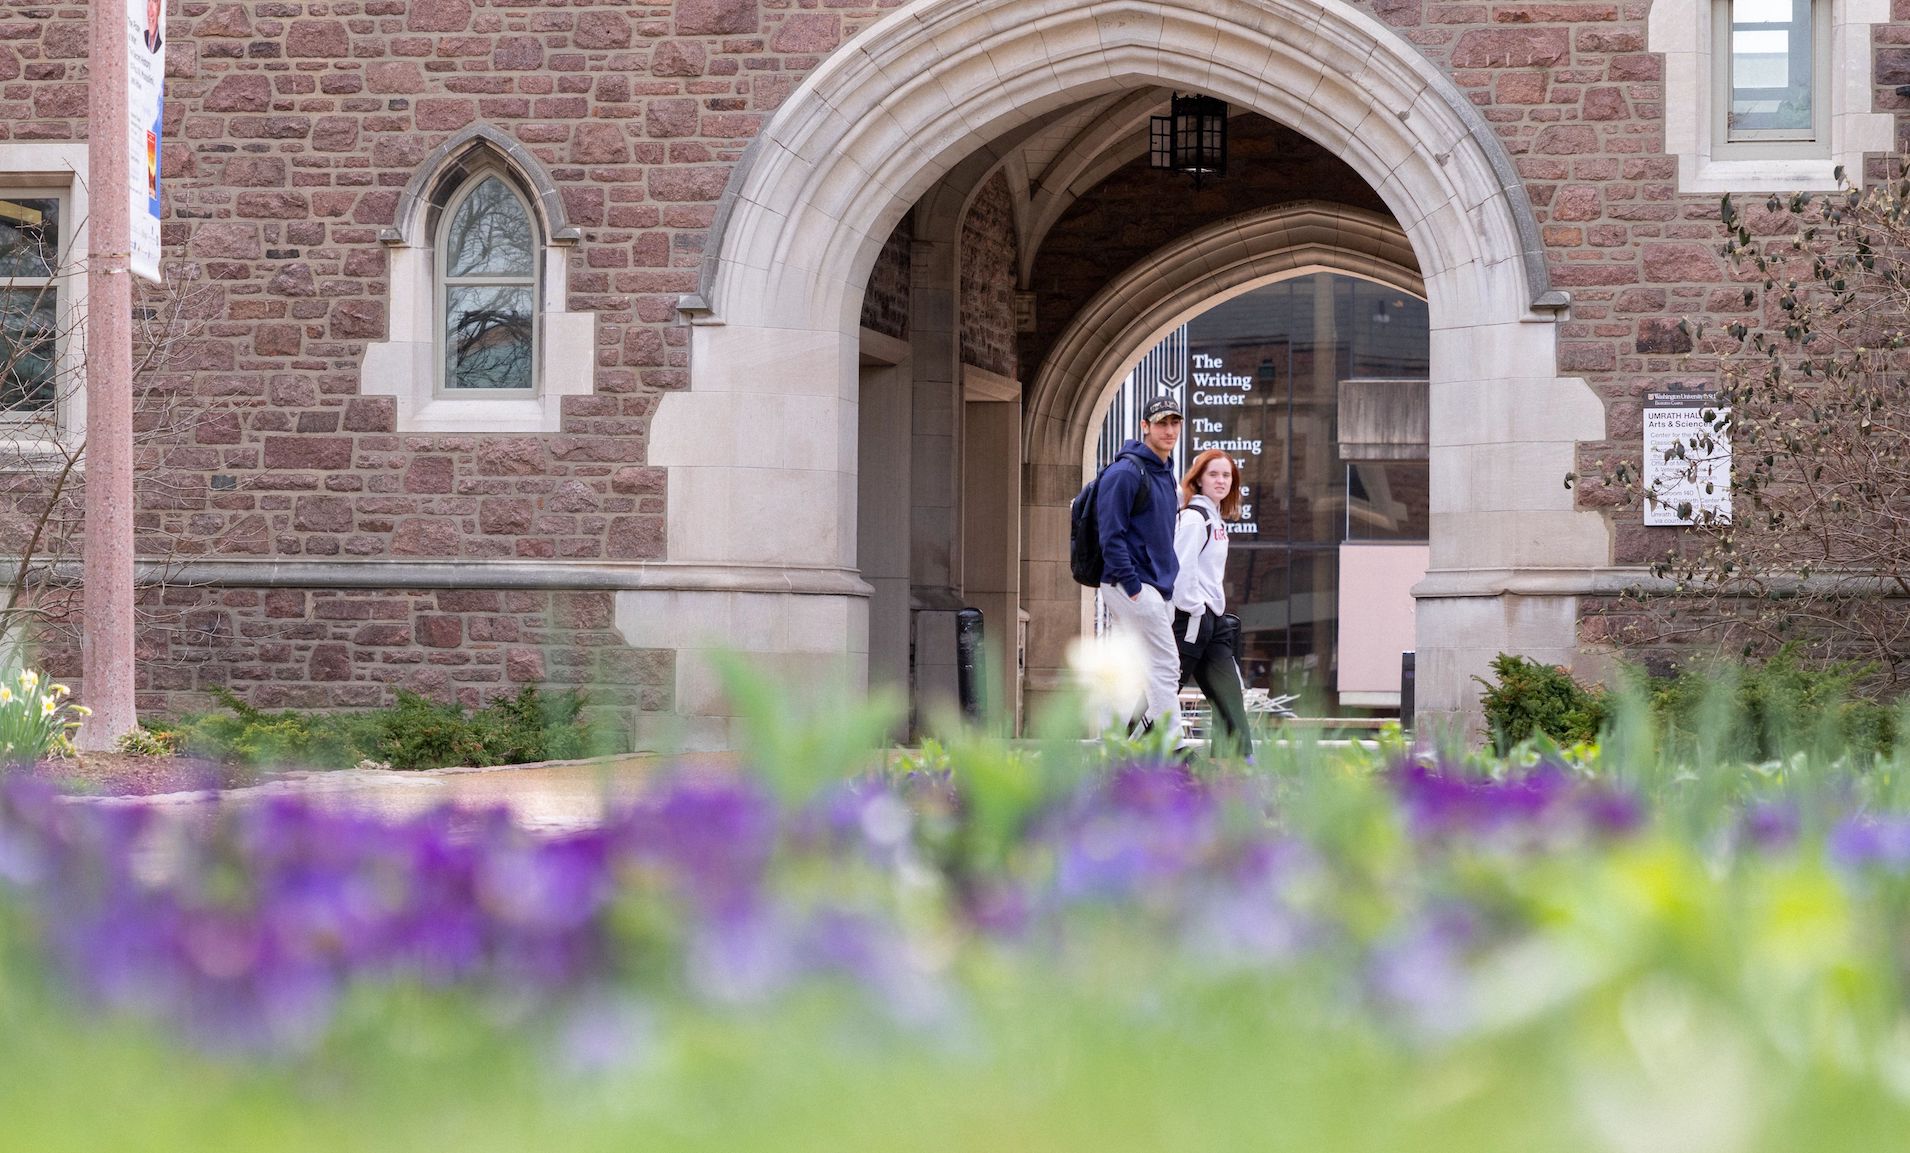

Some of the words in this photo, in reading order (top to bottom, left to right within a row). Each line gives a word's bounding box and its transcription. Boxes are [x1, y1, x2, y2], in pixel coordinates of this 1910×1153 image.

[1192, 354, 1222, 368] The
[1192, 373, 1252, 391] Writing
[1193, 391, 1245, 405] Center
[1192, 418, 1222, 432] The
[1193, 437, 1261, 455] Learning
